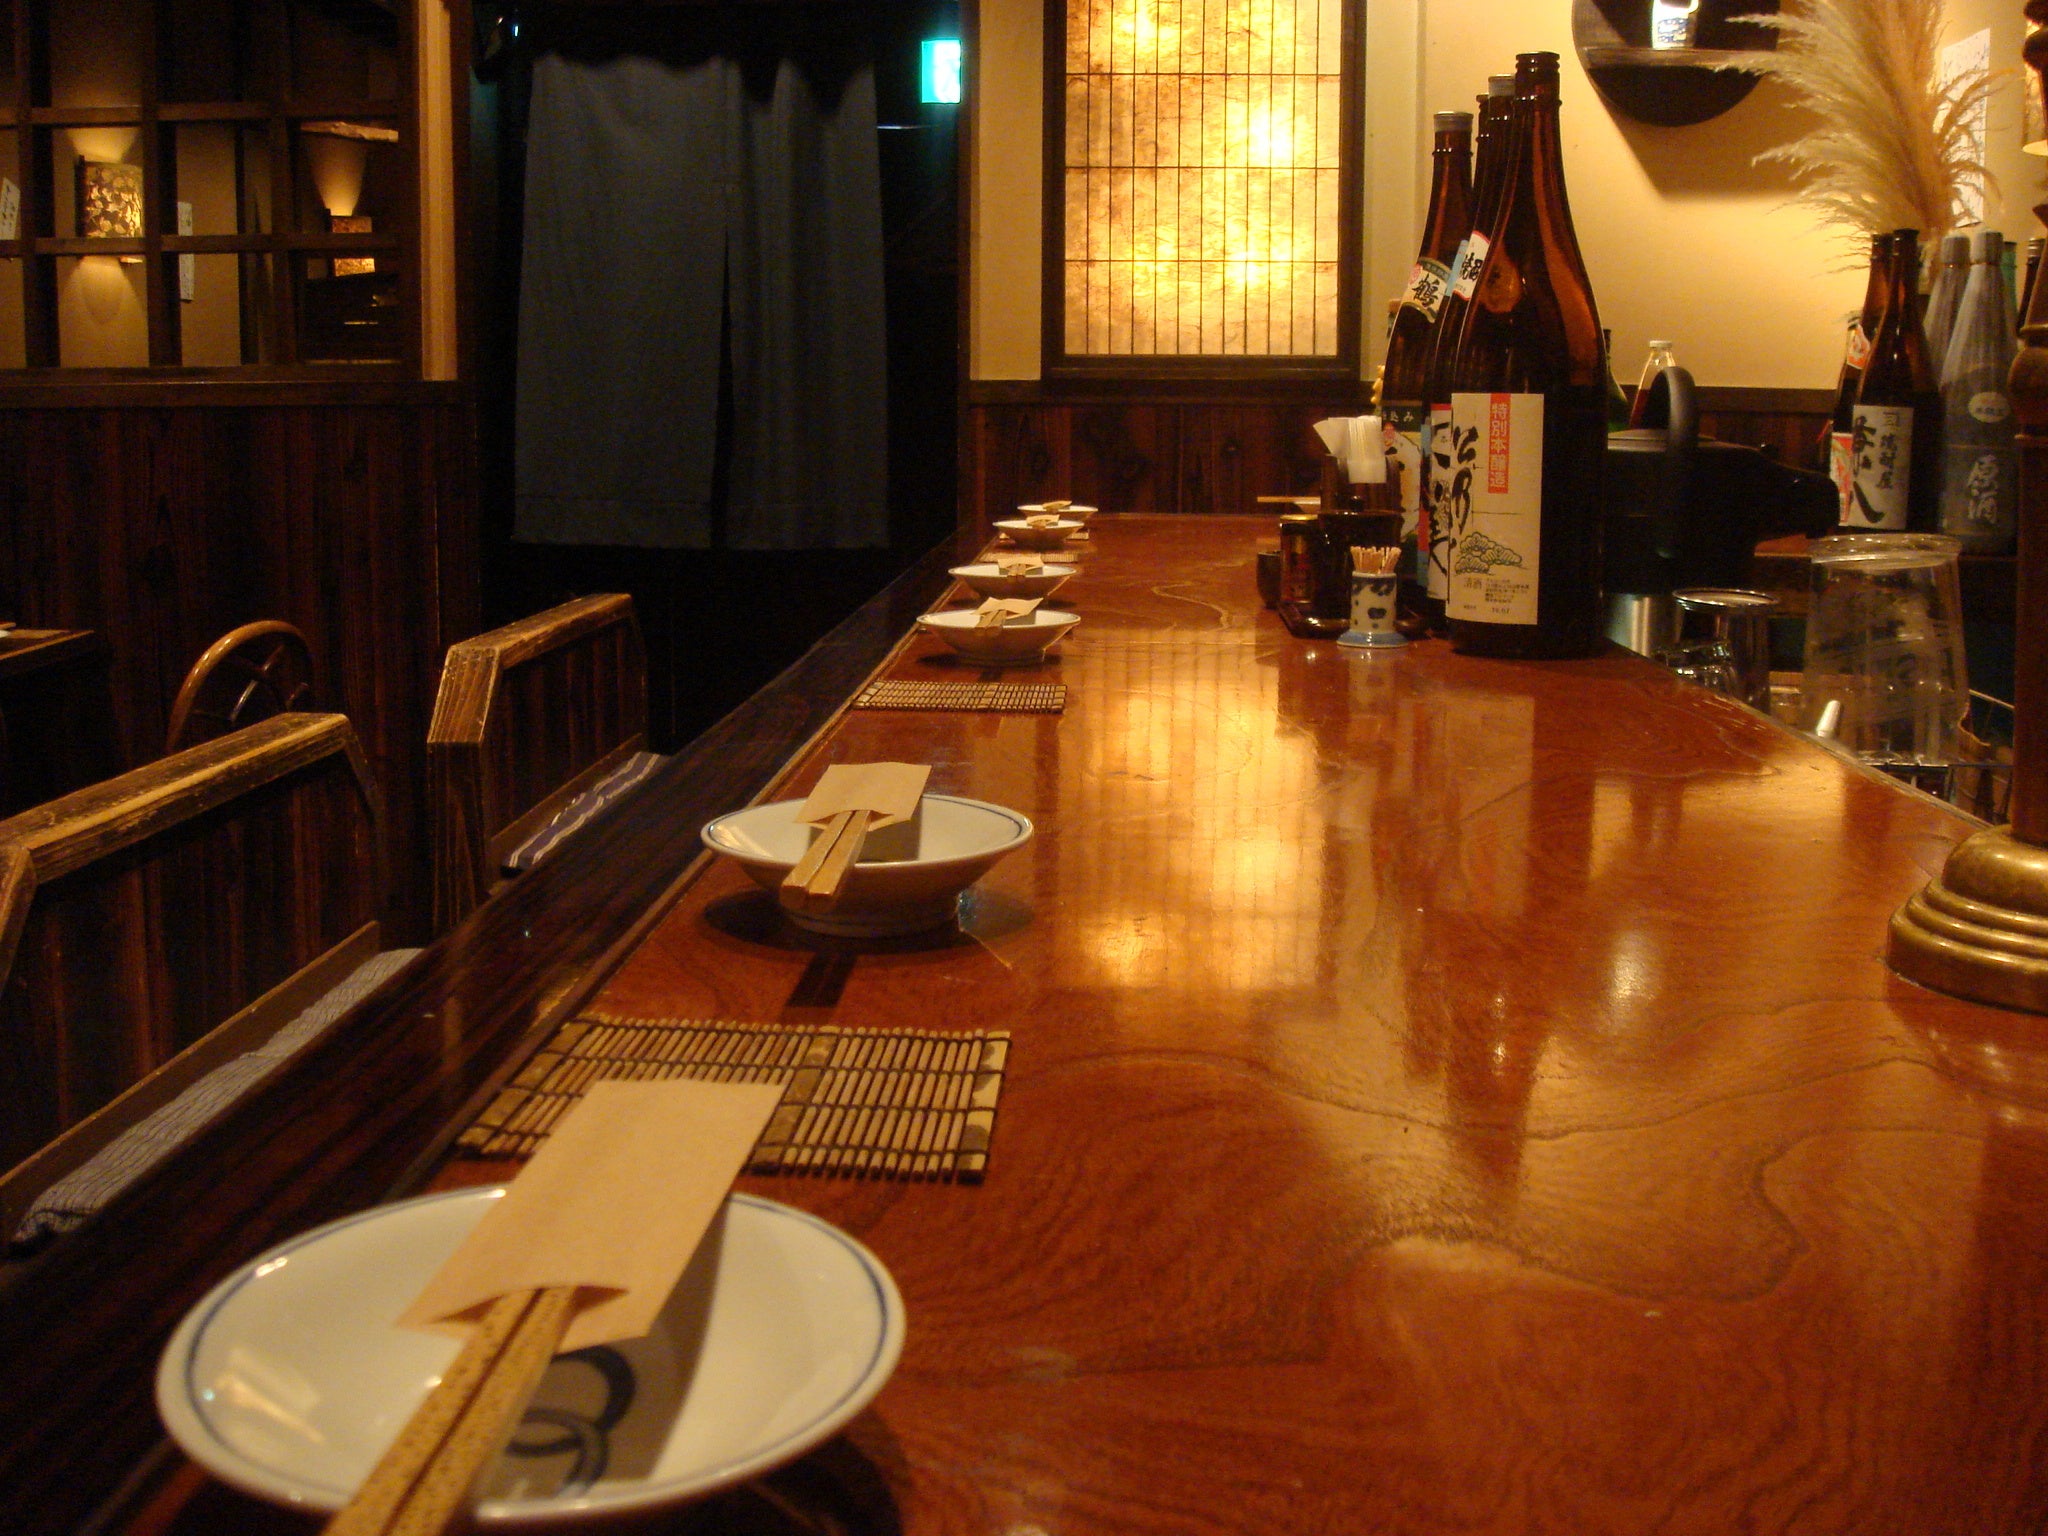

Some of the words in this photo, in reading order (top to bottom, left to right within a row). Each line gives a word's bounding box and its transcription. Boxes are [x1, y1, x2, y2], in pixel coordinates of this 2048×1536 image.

[1489, 402, 1510, 487] 特別本醸造
